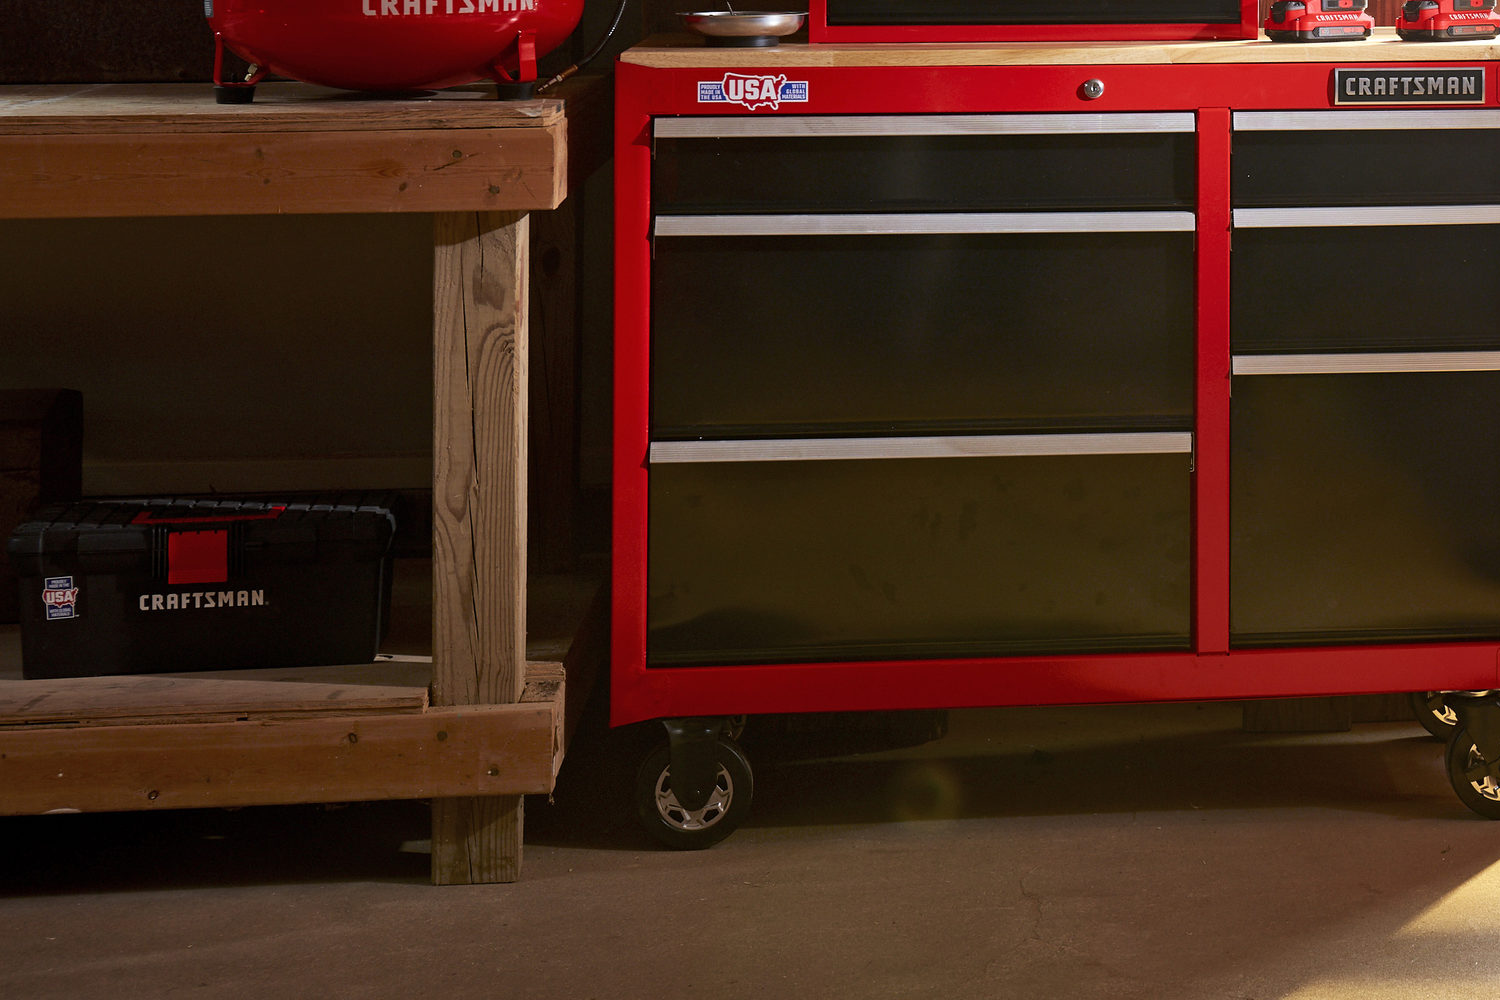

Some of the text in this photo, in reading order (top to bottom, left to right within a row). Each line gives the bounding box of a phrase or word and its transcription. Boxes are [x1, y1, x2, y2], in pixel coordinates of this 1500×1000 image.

[1316, 13, 1360, 22] CRAFTSMAN
[1448, 13, 1489, 21] CRAFTSMAN
[728, 79, 777, 100] USA
[1345, 76, 1475, 96] CRAFTSMAN
[46, 591, 74, 603] USA
[139, 589, 264, 611] CRAFTSMAN
